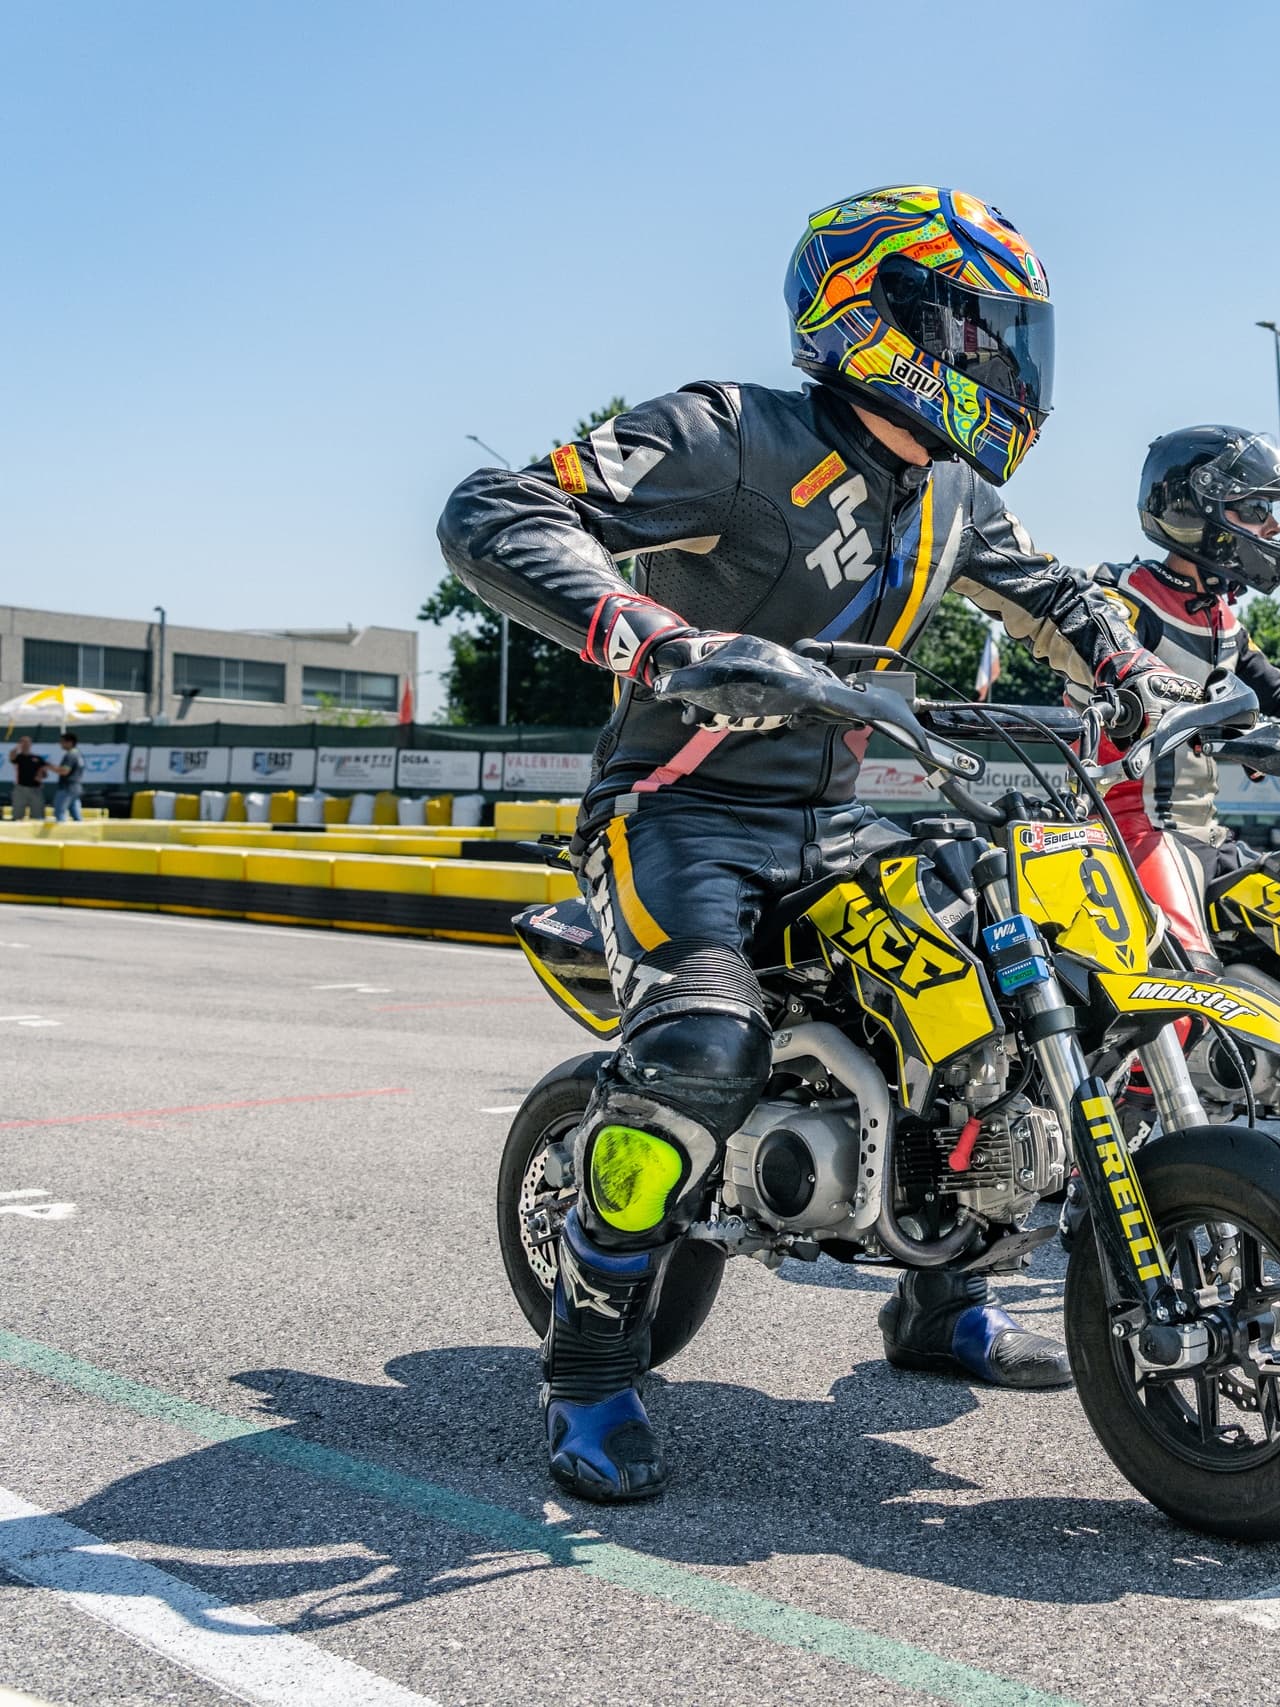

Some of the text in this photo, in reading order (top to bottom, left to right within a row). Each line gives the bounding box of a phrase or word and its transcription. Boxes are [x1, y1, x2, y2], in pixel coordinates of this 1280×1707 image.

[895, 360, 938, 394] agv
[507, 755, 579, 769] VALENTINO
[1079, 858, 1130, 943] 9
[1128, 982, 1259, 1020] Mobster
[1081, 1095, 1167, 1281] PIRELLI
